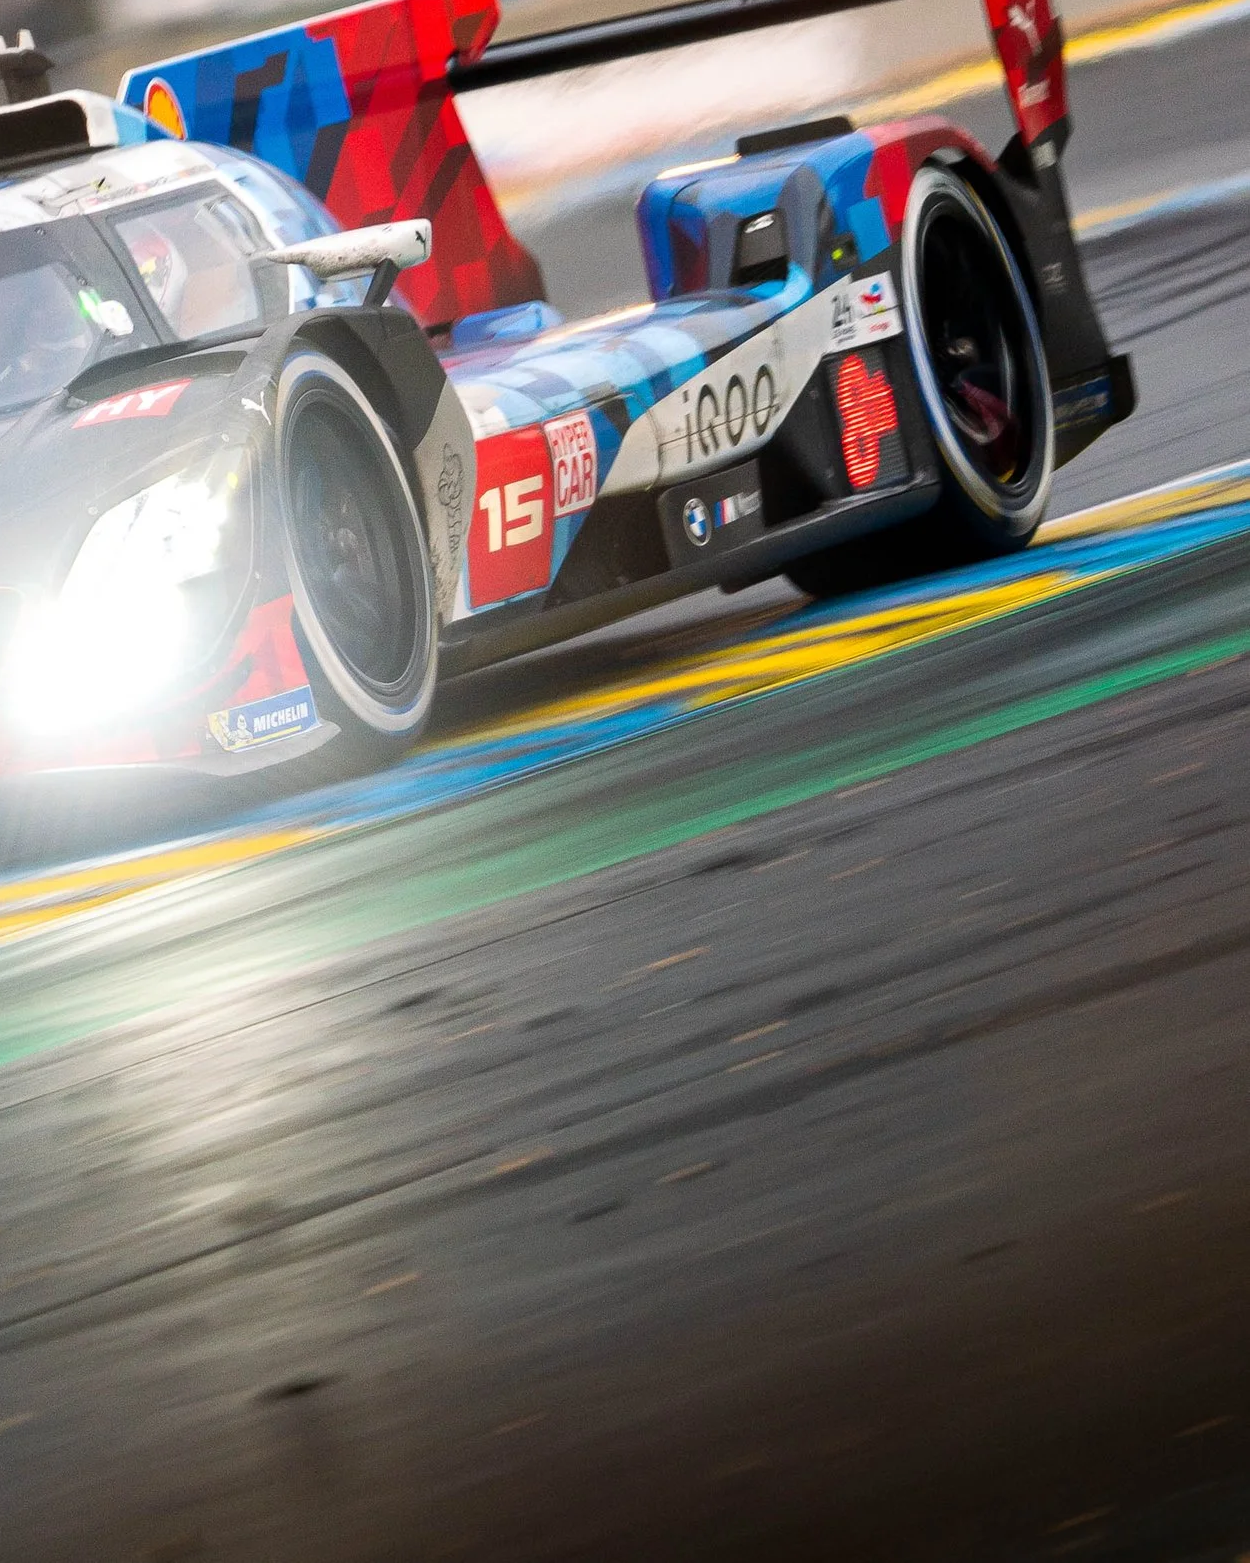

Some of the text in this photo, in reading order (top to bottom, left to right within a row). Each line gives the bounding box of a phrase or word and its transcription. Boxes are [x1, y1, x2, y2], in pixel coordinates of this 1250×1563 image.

[83, 384, 183, 413] HY
[557, 452, 593, 508] CAR
[479, 475, 544, 553] 15
[253, 702, 309, 733] MICHELIN
